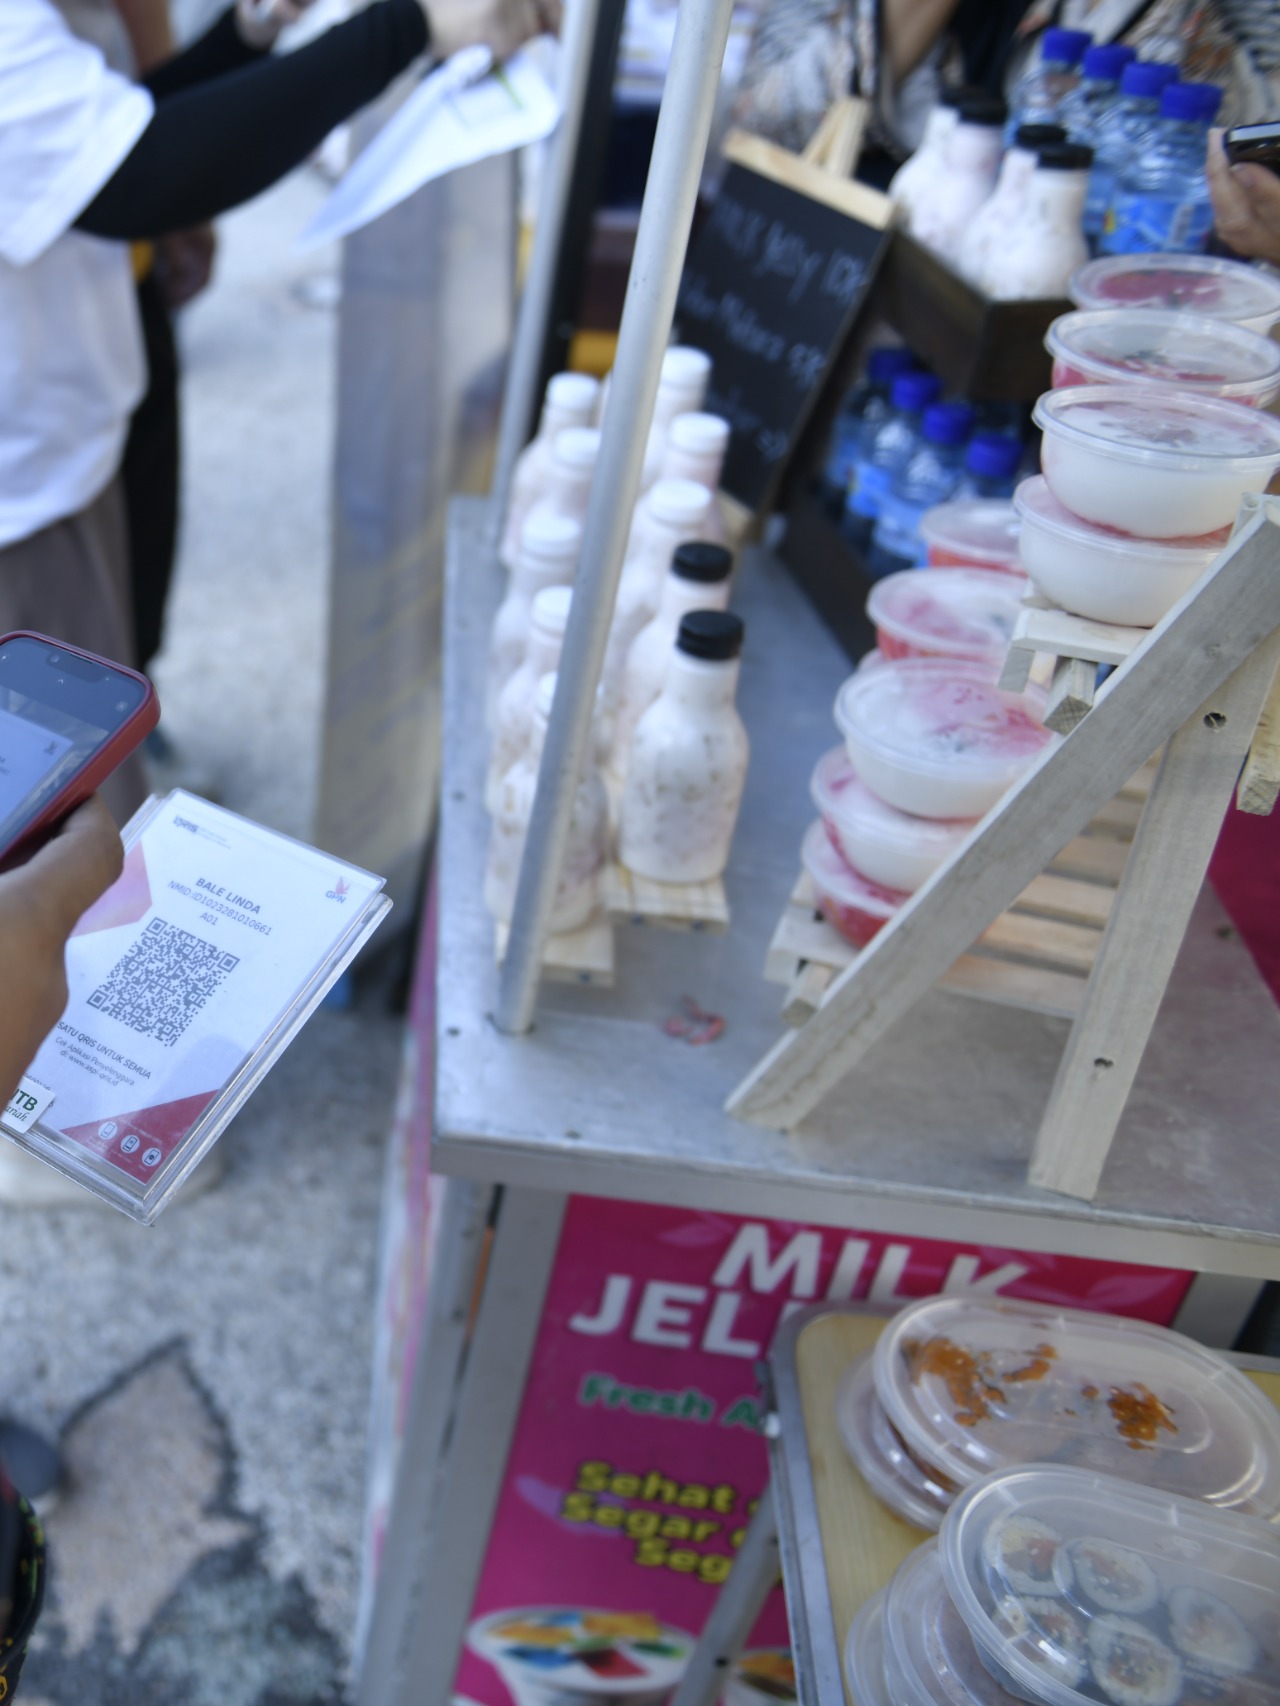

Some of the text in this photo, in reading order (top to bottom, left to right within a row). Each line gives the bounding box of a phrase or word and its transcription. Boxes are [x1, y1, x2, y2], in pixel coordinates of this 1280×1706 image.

[195, 877, 261, 915] BALE LINDA
[200, 912, 219, 926] A01
[325, 890, 347, 904] GPN
[55, 1036, 135, 1086] Cek Aplikasi Penyelenggara
[57, 1021, 152, 1080] SATU QRIS UNTUK SEMUA
[6, 1106, 30, 1122] ariah
[712, 1222, 1030, 1308] MILK
[568, 1274, 805, 1358] JEL
[581, 1372, 715, 1426] Fresh
[578, 1461, 735, 1514] Sehat
[561, 1493, 720, 1543] Segar
[634, 1537, 734, 1585] Seg
